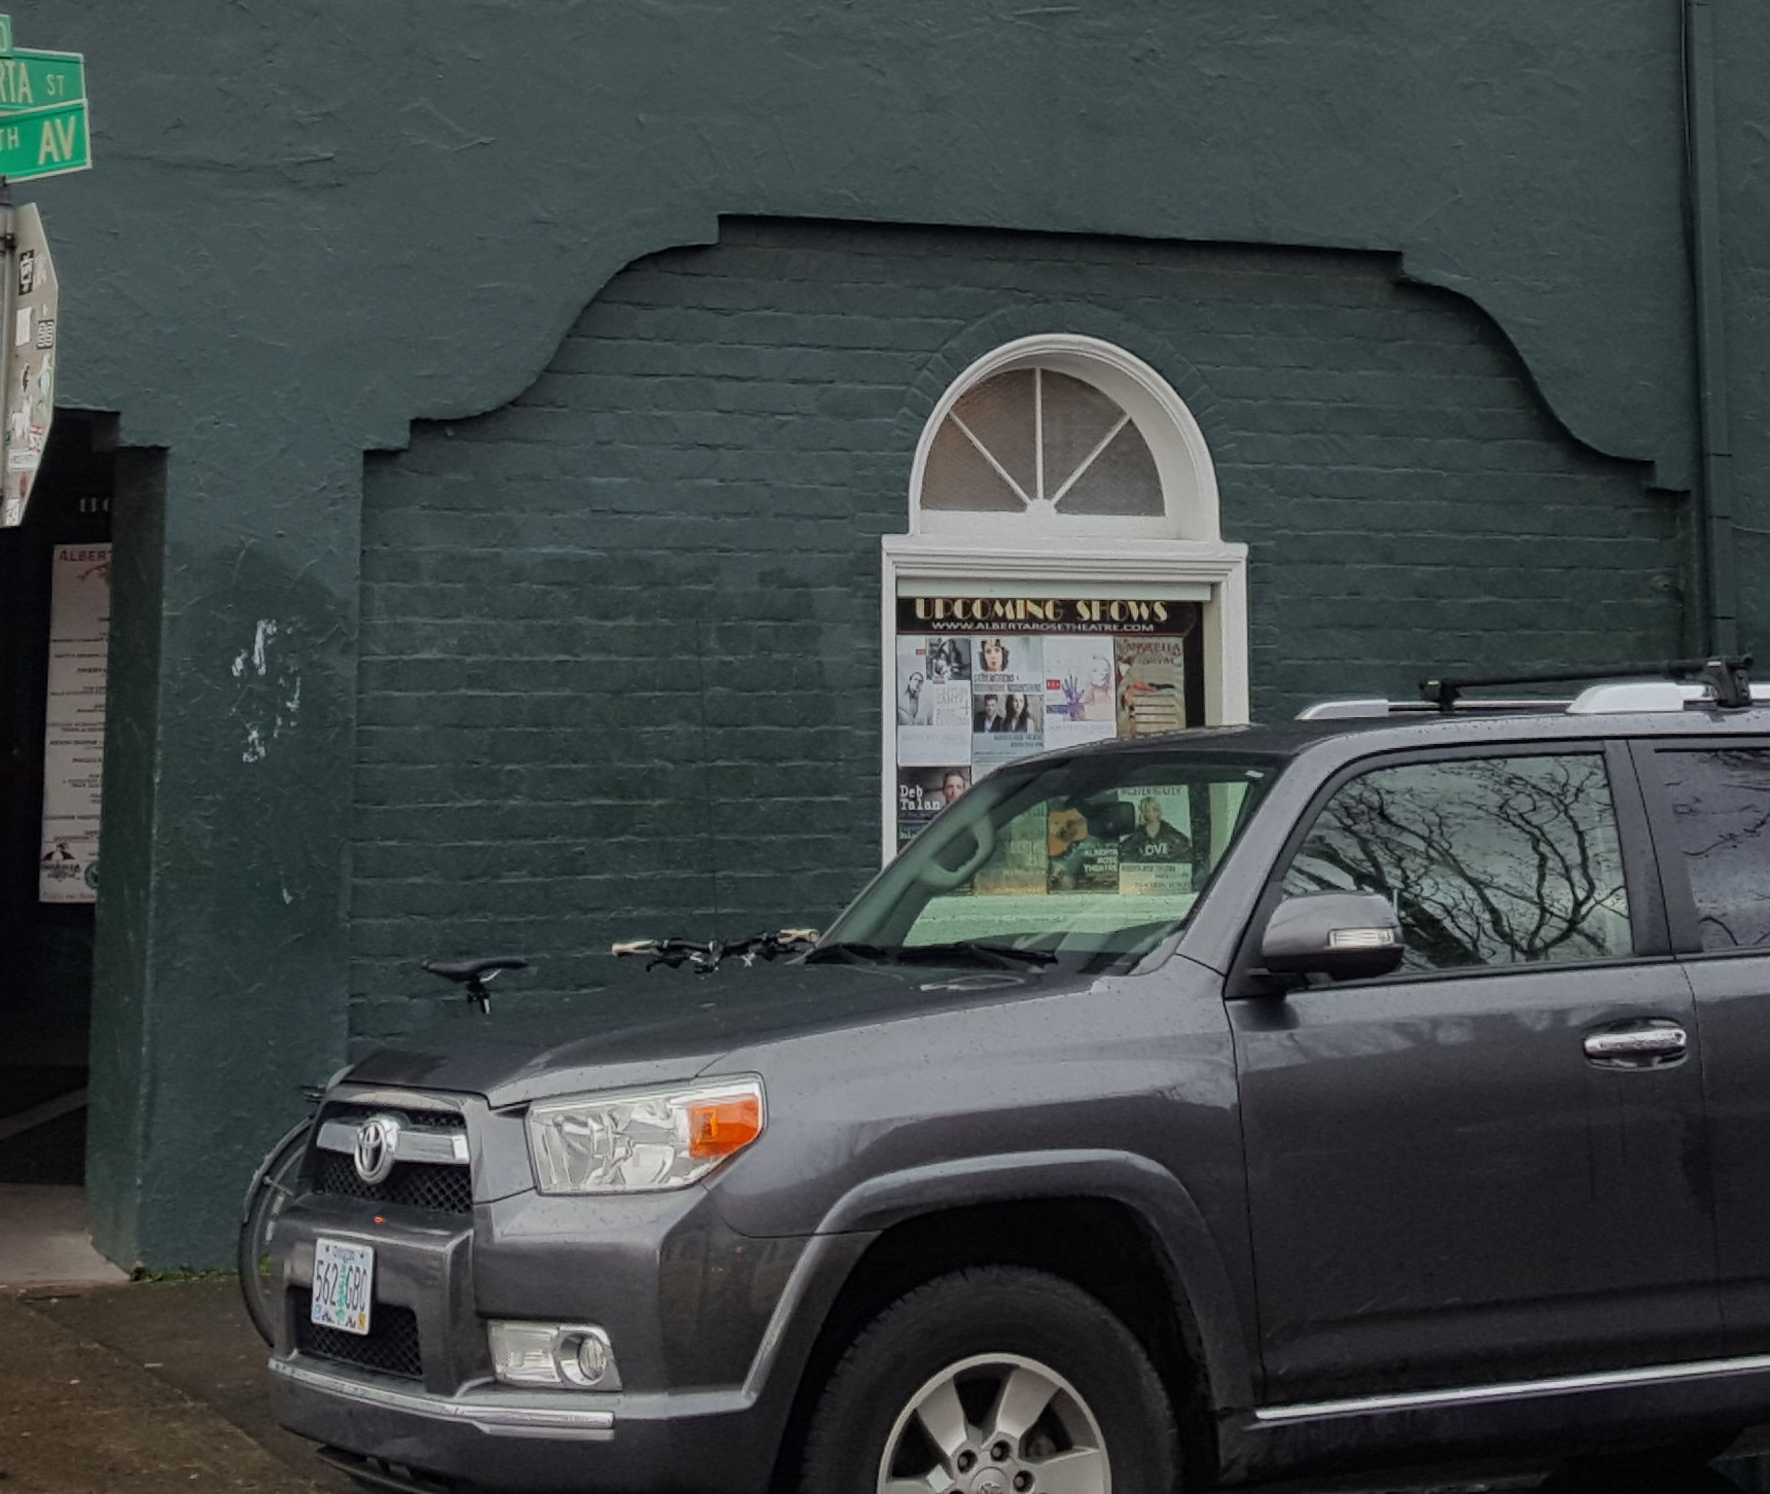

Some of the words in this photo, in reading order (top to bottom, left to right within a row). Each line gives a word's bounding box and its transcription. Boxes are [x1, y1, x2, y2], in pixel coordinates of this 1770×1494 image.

[46, 74, 65, 96] ST
[38, 115, 76, 165] AV
[915, 598, 1065, 621] UPCOMING
[1076, 600, 1168, 623] SHOWS
[932, 621, 1154, 632] WWW.ALBERTAROSETHEATRE.COM
[900, 798, 941, 811] Talan
[315, 1260, 338, 1306] 562
